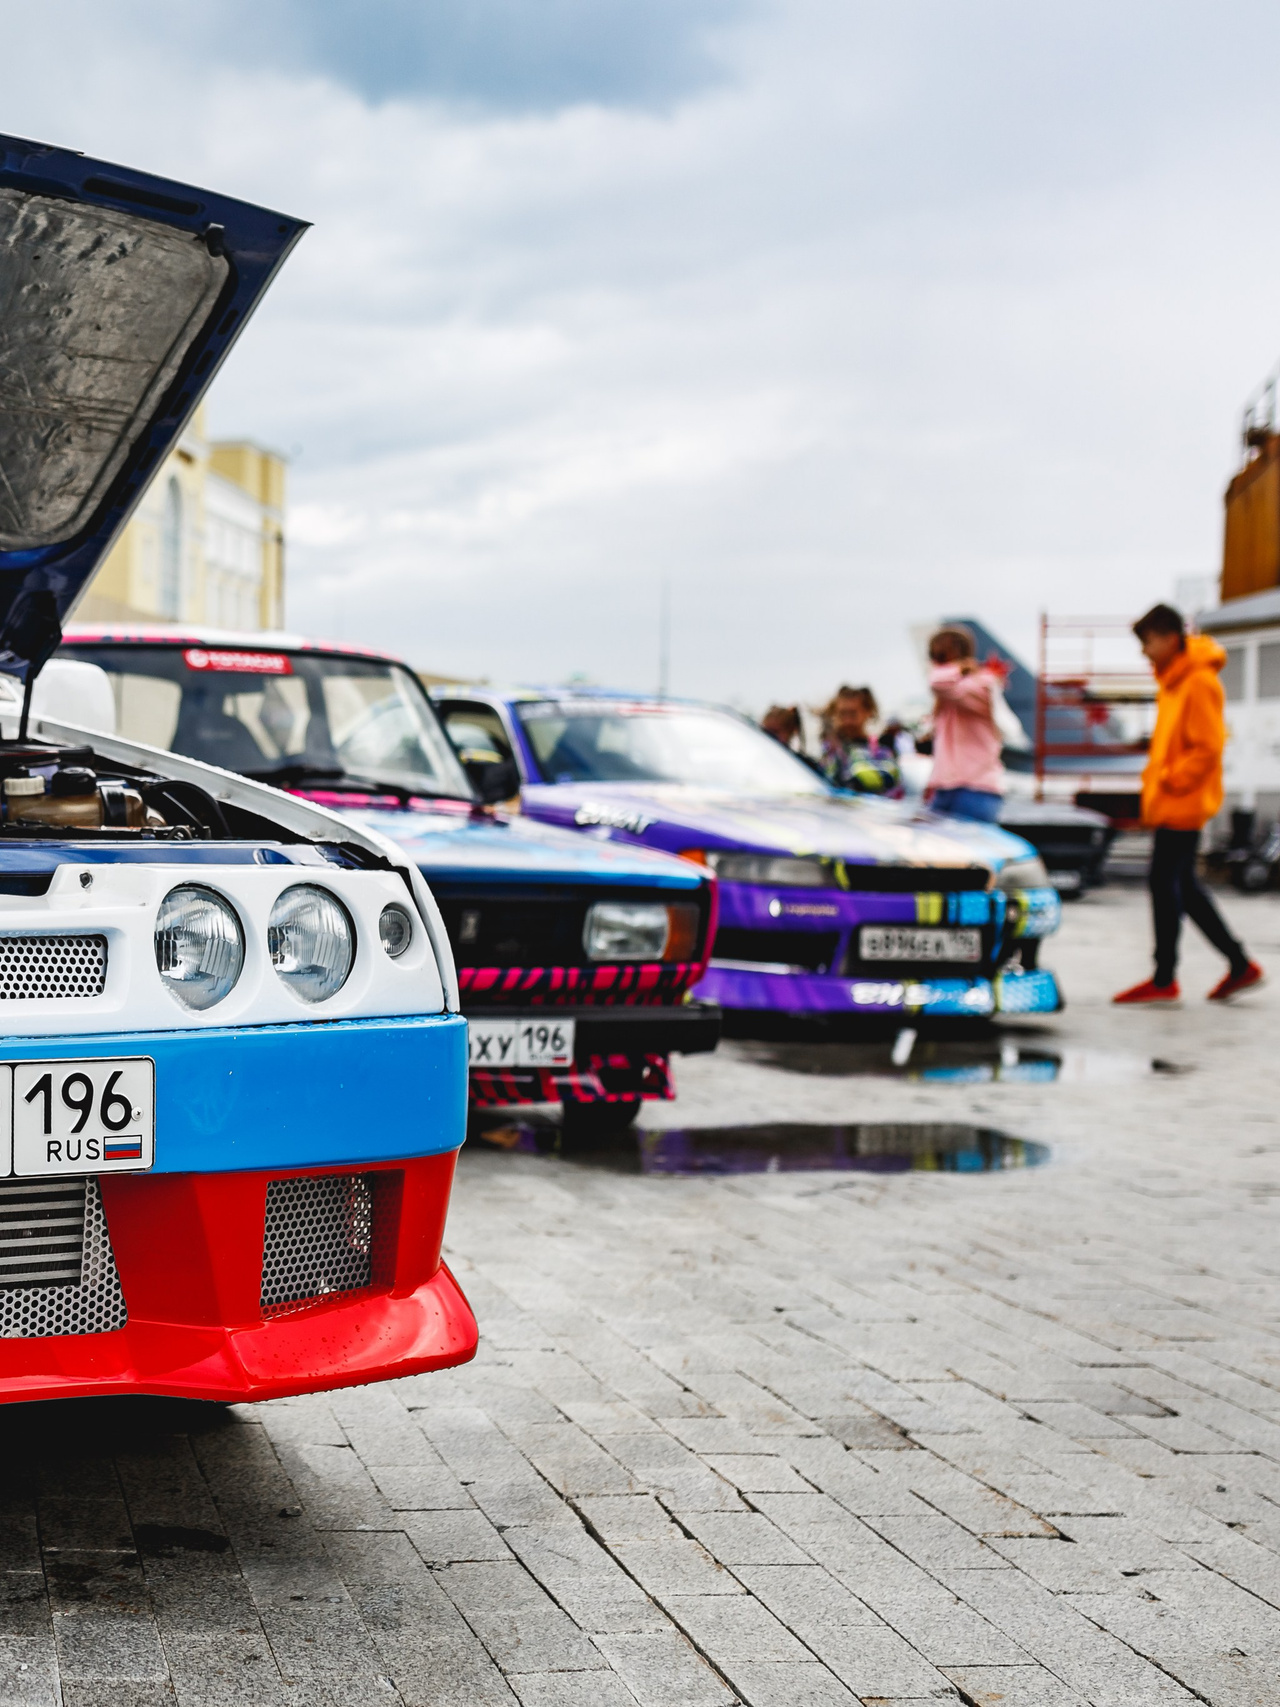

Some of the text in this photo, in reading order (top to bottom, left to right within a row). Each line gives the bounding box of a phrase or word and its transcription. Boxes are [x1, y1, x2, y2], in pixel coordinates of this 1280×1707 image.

[469, 1026, 566, 1060] ХУ 196
[24, 1070, 132, 1135] 196
[47, 1138, 100, 1163] RUS
